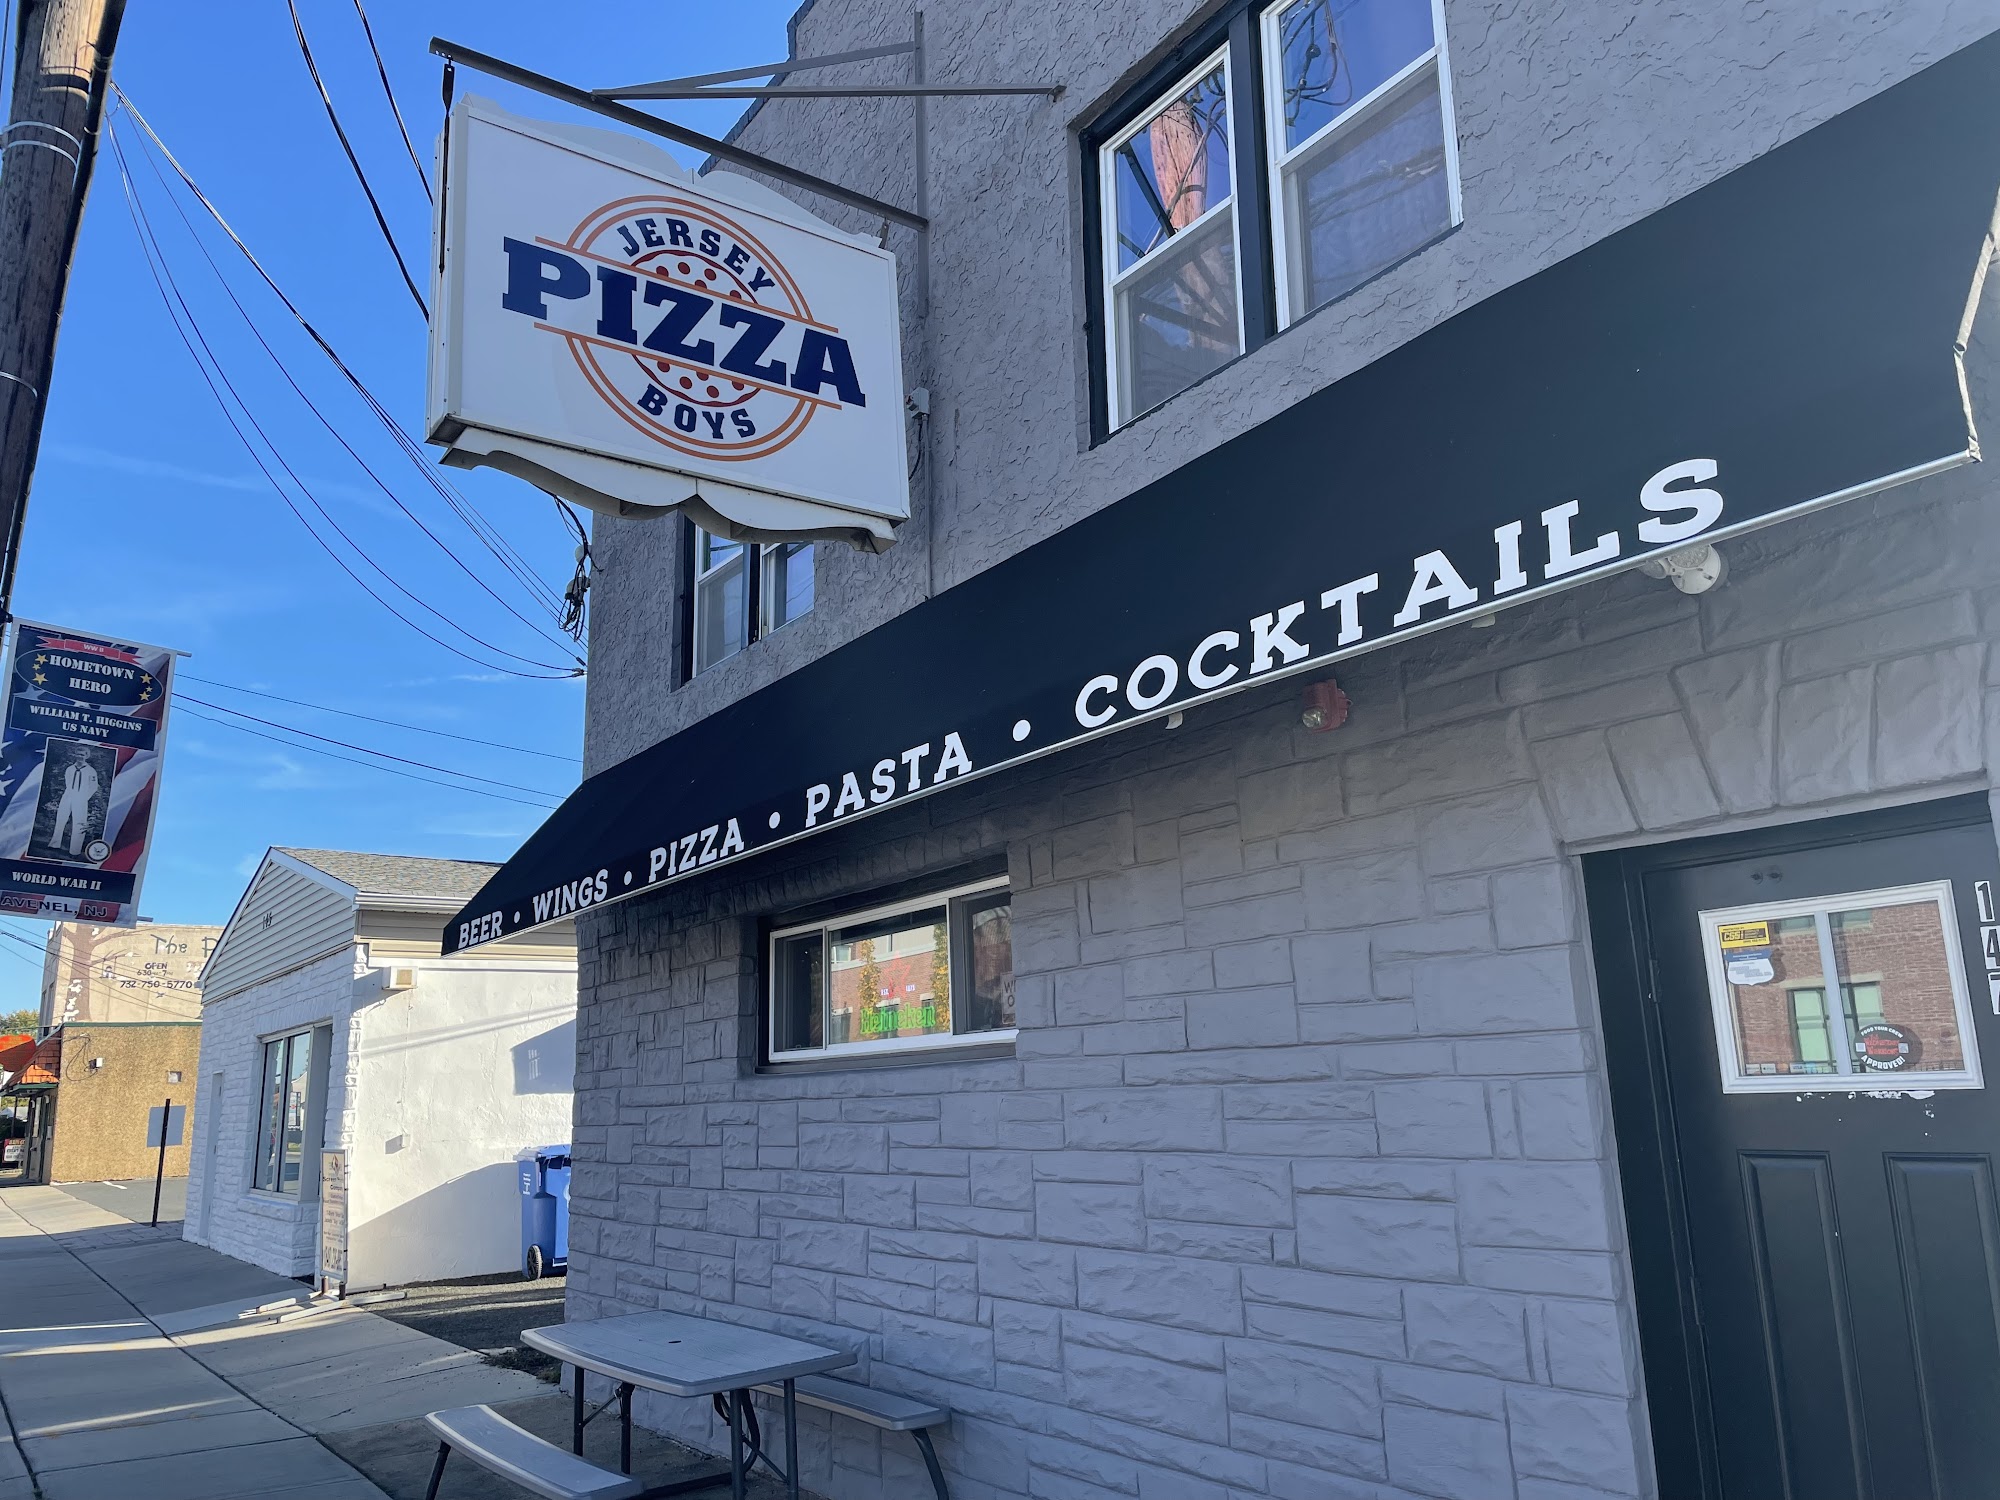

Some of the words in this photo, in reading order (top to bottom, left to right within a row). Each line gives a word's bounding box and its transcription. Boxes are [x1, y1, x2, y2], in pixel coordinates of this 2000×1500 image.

[616, 218, 775, 293] JERSEY
[502, 236, 866, 407] PIZZA
[637, 383, 756, 439] BOYS
[84, 644, 98, 652] WW
[49, 654, 135, 680] HOMETOWN
[69, 677, 112, 694] HERO
[458, 910, 503, 949] BEER
[532, 869, 609, 923] WINGS
[648, 817, 745, 883] PIZZA
[805, 731, 972, 828] PASTA
[1075, 458, 1724, 728] COCKTAILS
[30, 705, 80, 721] WILLIAM
[82, 713, 93, 723] T.
[96, 716, 142, 731] HIGGINS
[62, 722, 78, 732] US
[80, 724, 110, 738] NAVY
[12, 871, 57, 886] WORLD
[60, 876, 88, 890] WAR
[90, 880, 102, 891] II
[1, 896, 78, 916] AVENEL,
[84, 904, 107, 917] NJ
[151, 934, 188, 955] The
[144, 962, 168, 970] OPEN
[120, 980, 193, 989] 732-750-5770
[860, 1002, 936, 1034] Heineken
[1860, 1054, 1906, 1070] APPROVED!
